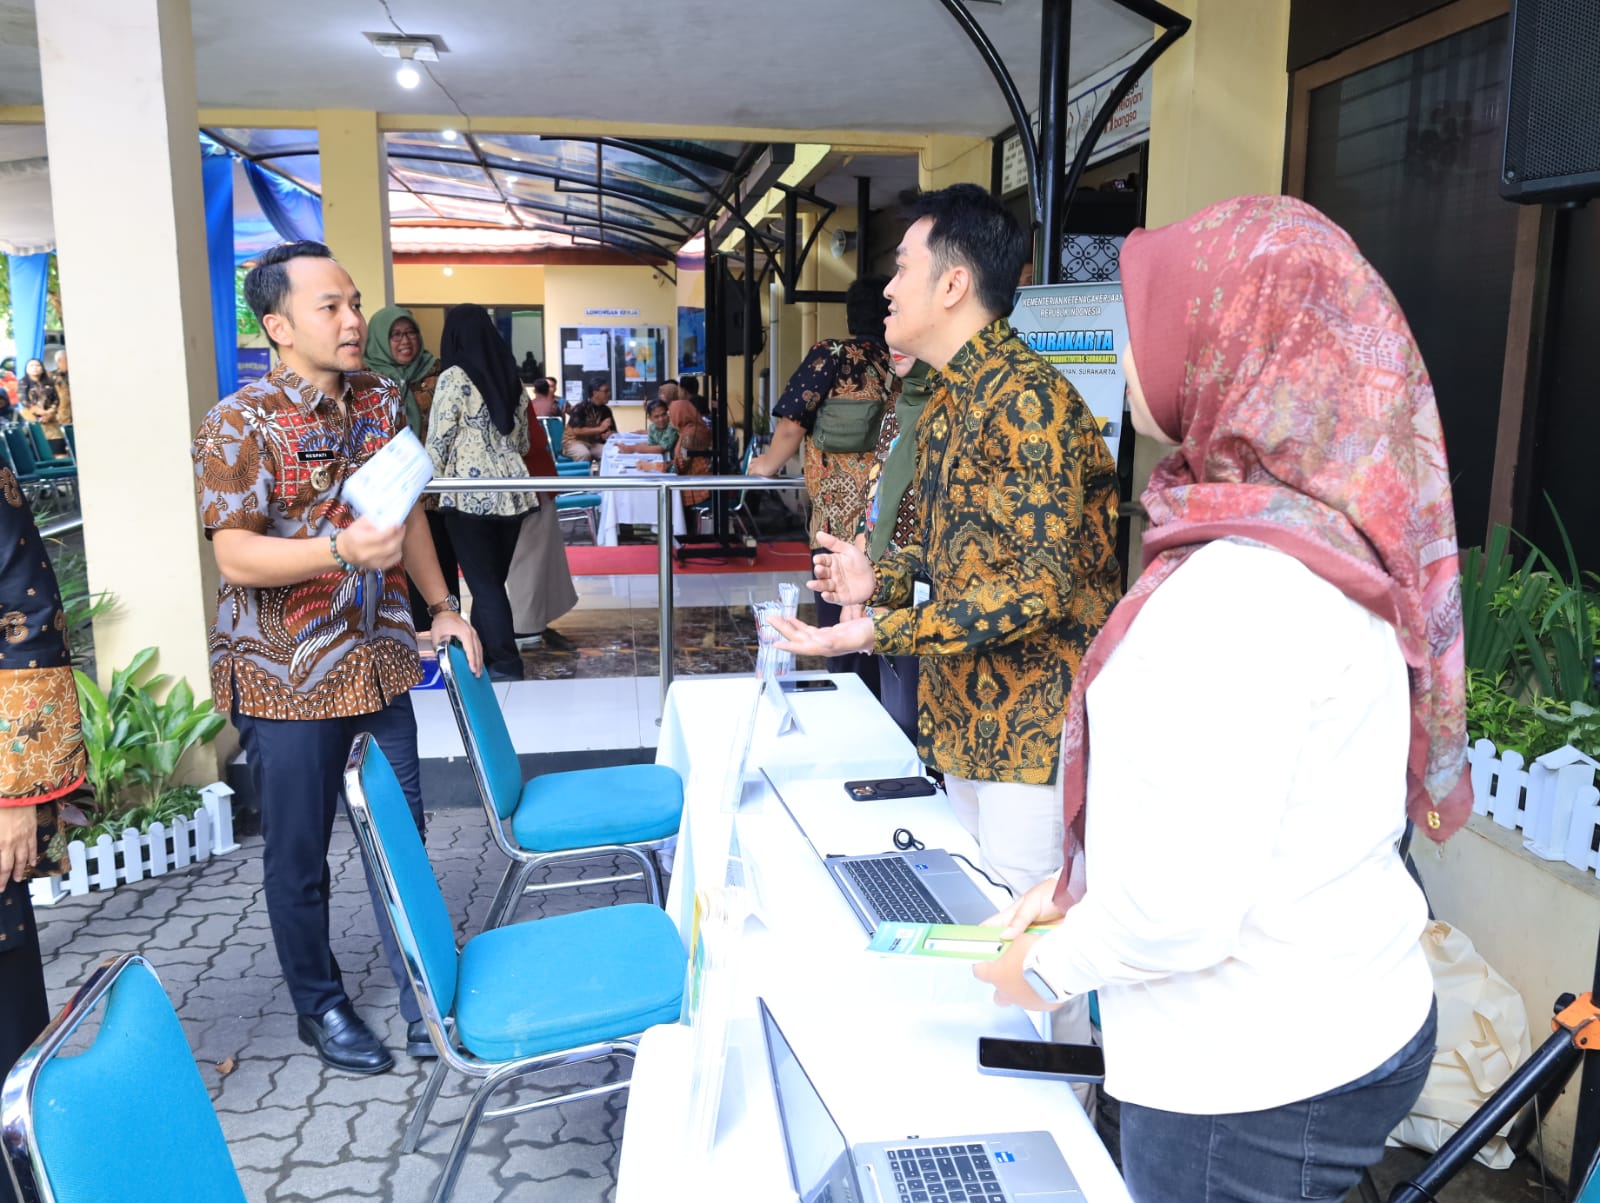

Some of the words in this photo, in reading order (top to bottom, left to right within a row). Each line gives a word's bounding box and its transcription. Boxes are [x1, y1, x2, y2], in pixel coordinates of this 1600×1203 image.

[1113, 110, 1137, 129] bangsa
[1023, 297, 1062, 306] KEMENTERIAN
[1040, 308, 1069, 318] REPUBLIK
[1070, 307, 1101, 317] INDONESIA
[1027, 329, 1114, 352] SURAKARTA
